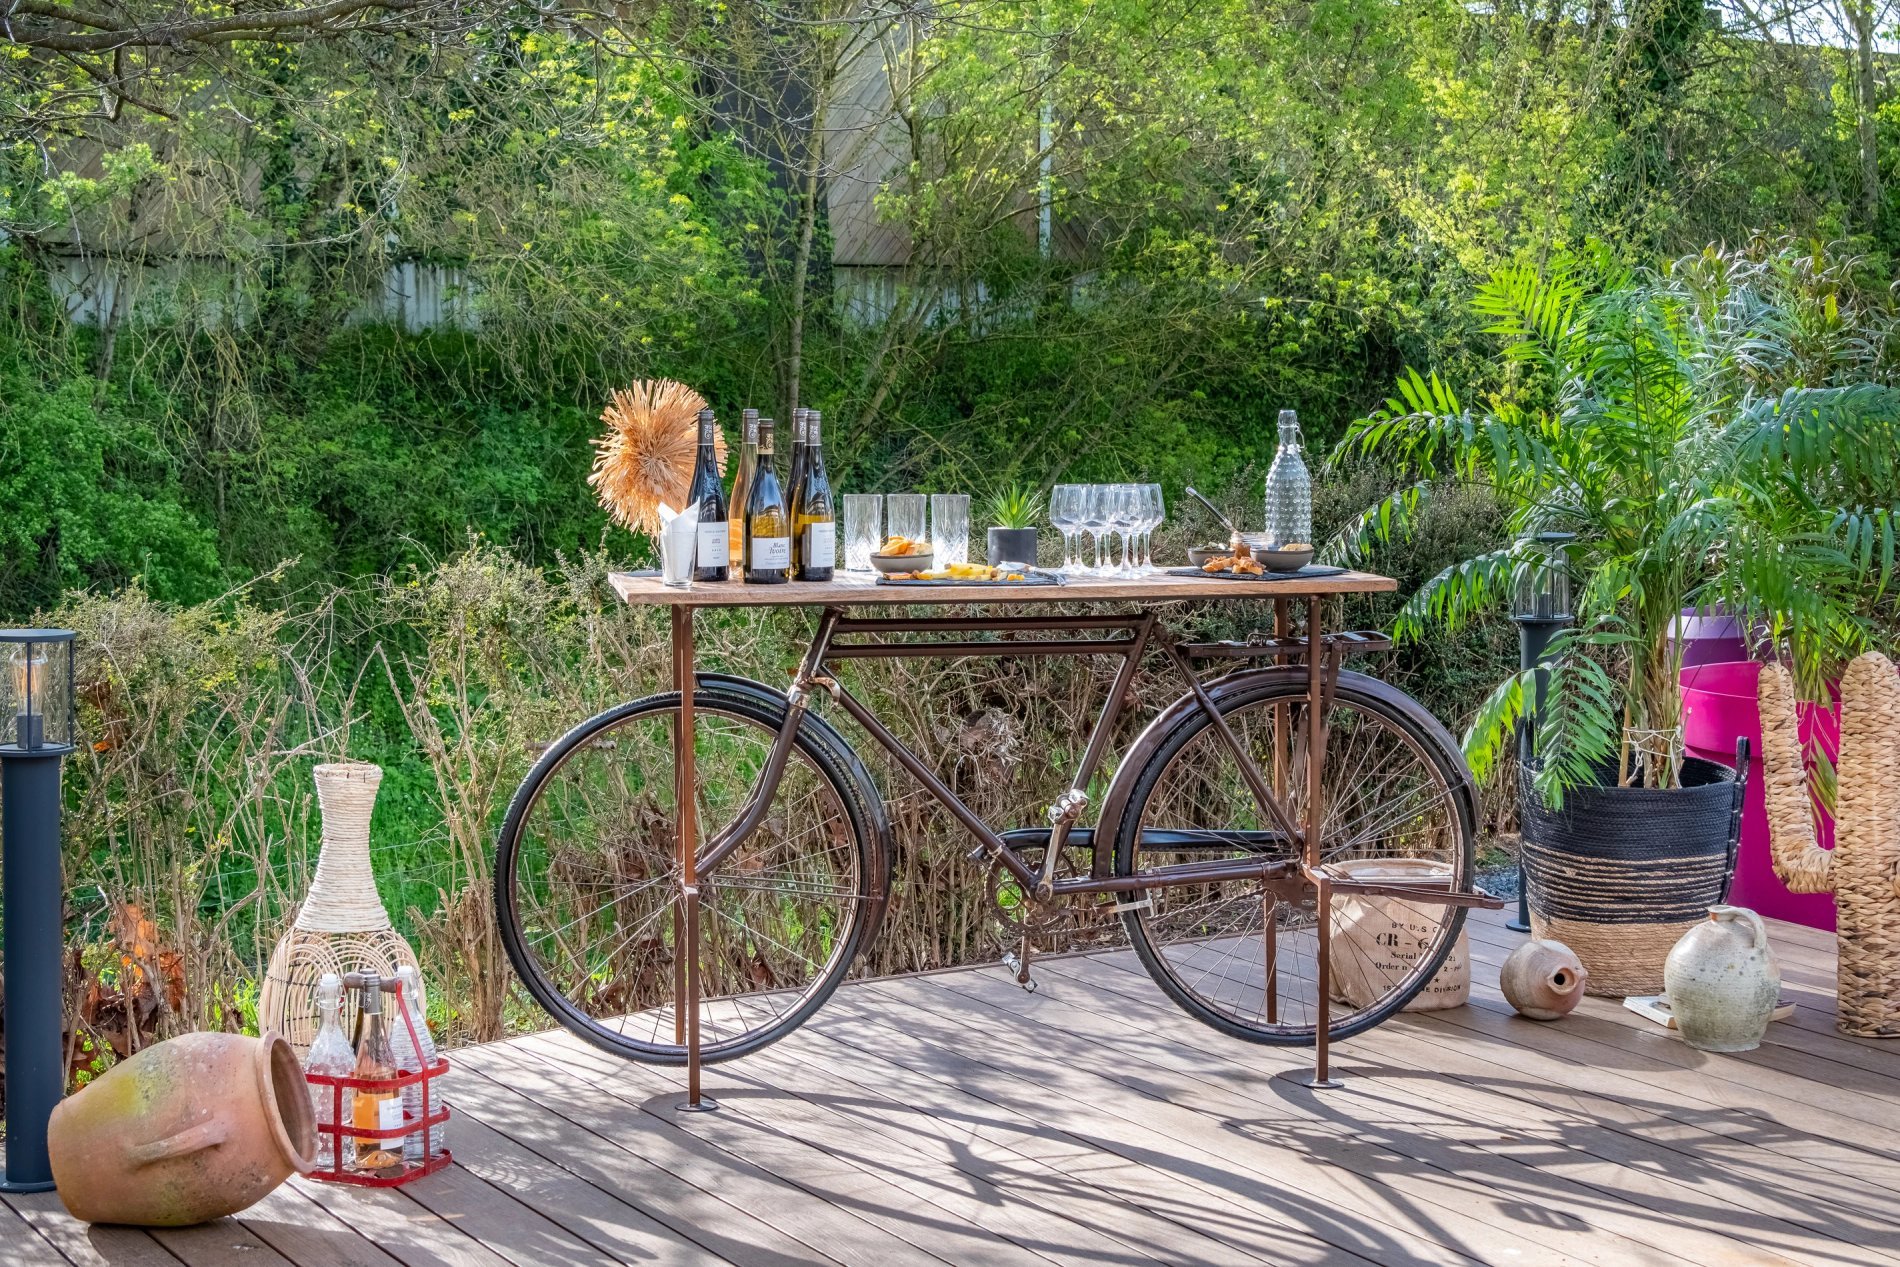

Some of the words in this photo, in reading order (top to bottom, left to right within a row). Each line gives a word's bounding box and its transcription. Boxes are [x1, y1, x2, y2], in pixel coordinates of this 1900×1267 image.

[1376, 932, 1399, 947] CR
[1390, 952, 1417, 960] Serial
[1375, 961, 1400, 970] Order
